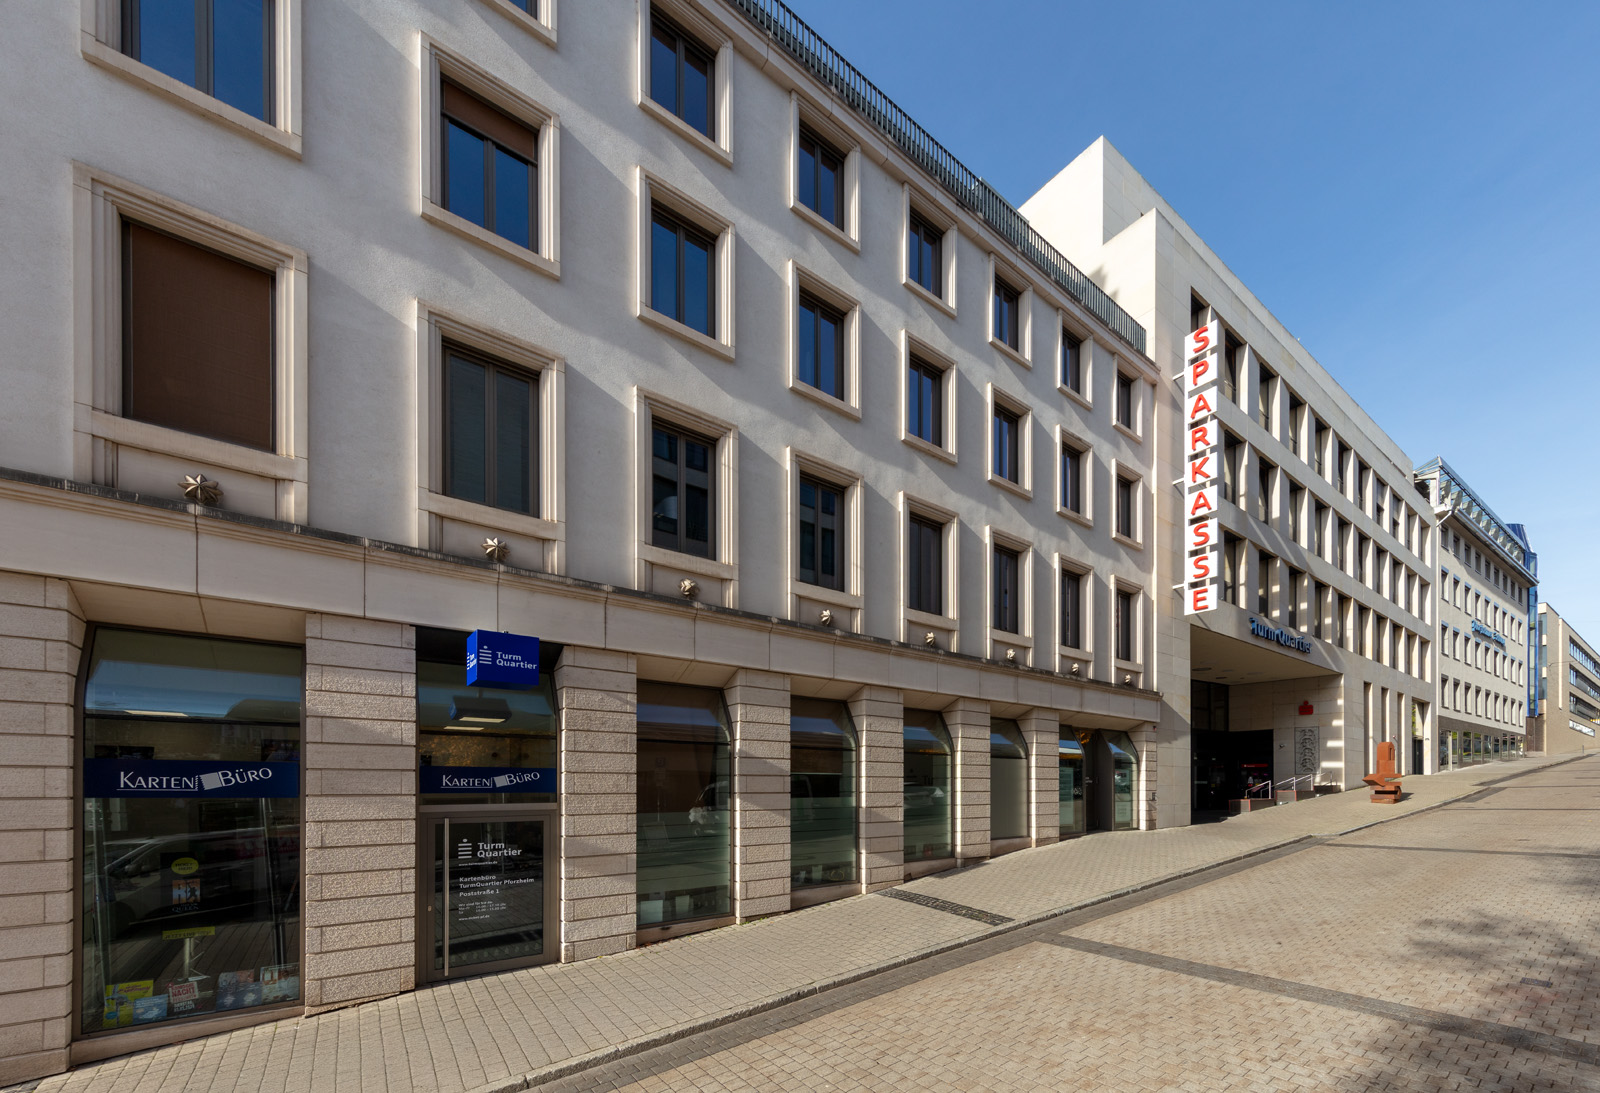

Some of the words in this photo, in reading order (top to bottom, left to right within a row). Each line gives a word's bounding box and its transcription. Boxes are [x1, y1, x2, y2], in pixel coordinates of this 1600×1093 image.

[1190, 326, 1212, 611] SPARKASSE
[496, 651, 522, 661] Turm
[496, 659, 538, 669] Quartier
[119, 771, 195, 789] KARTEN
[217, 767, 273, 787] BÜRO
[442, 774, 491, 787] KARTEN
[504, 771, 540, 785] BÜRO
[477, 842, 505, 850] Turm
[477, 848, 522, 858] Quartier
[459, 881, 502, 889] TurmQuartier
[503, 877, 535, 885] Pforzheim
